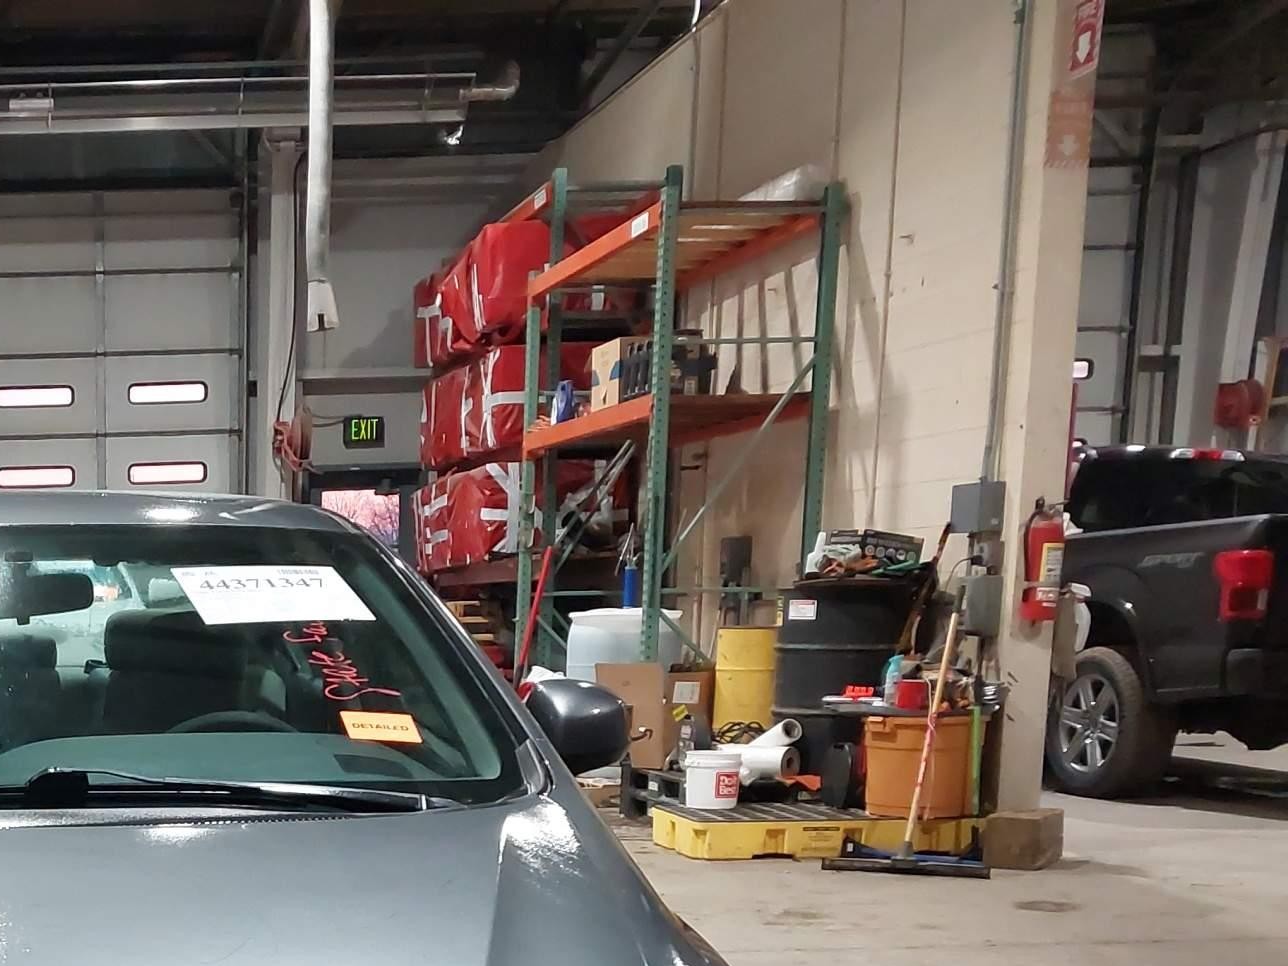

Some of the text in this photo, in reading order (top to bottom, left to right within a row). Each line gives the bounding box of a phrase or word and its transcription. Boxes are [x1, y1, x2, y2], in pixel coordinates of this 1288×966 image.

[351, 419, 379, 440] EXIT
[199, 577, 324, 591] 44371347
[351, 722, 410, 732] DETAILED
